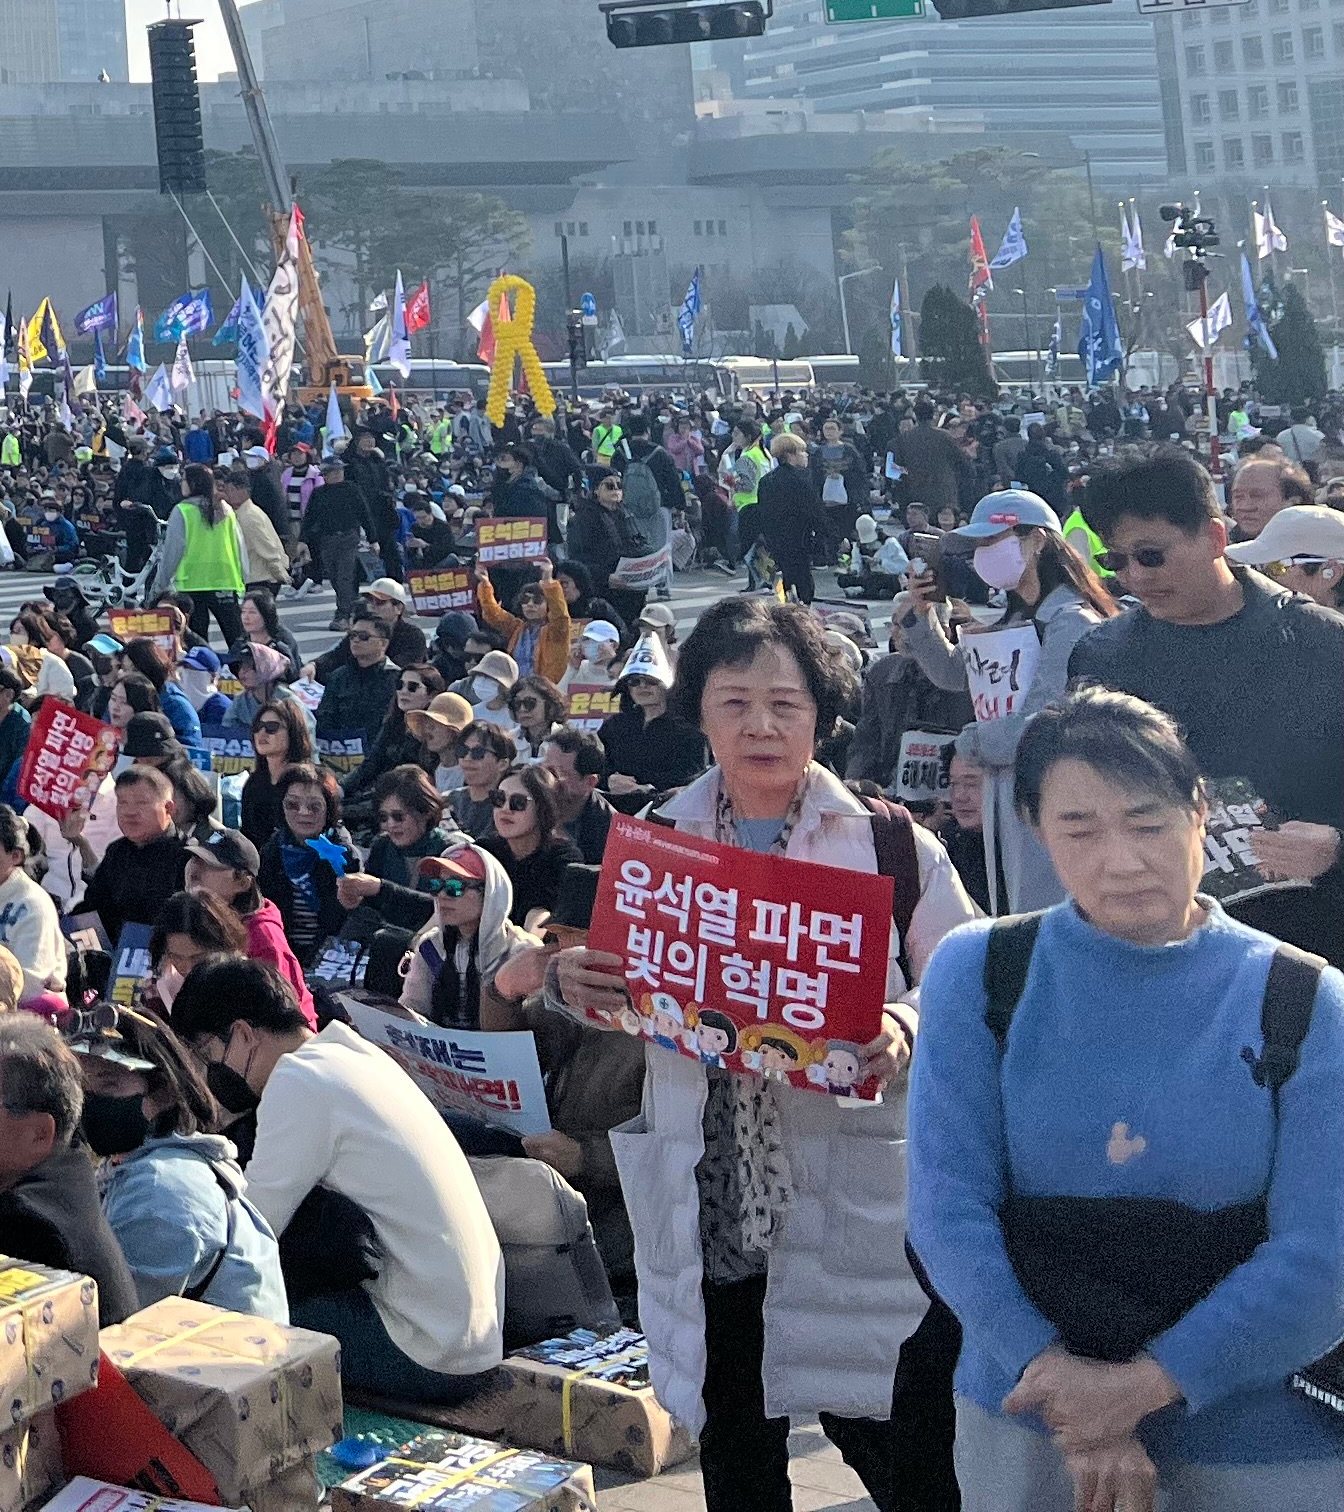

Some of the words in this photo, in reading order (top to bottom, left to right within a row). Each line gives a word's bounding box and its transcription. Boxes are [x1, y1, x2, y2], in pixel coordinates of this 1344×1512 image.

[29, 747, 63, 806] 윤석열
[614, 859, 739, 948] 윤석열
[748, 896, 864, 973] 파면
[624, 926, 710, 1004] 빛의
[720, 953, 830, 1030] 혁명
